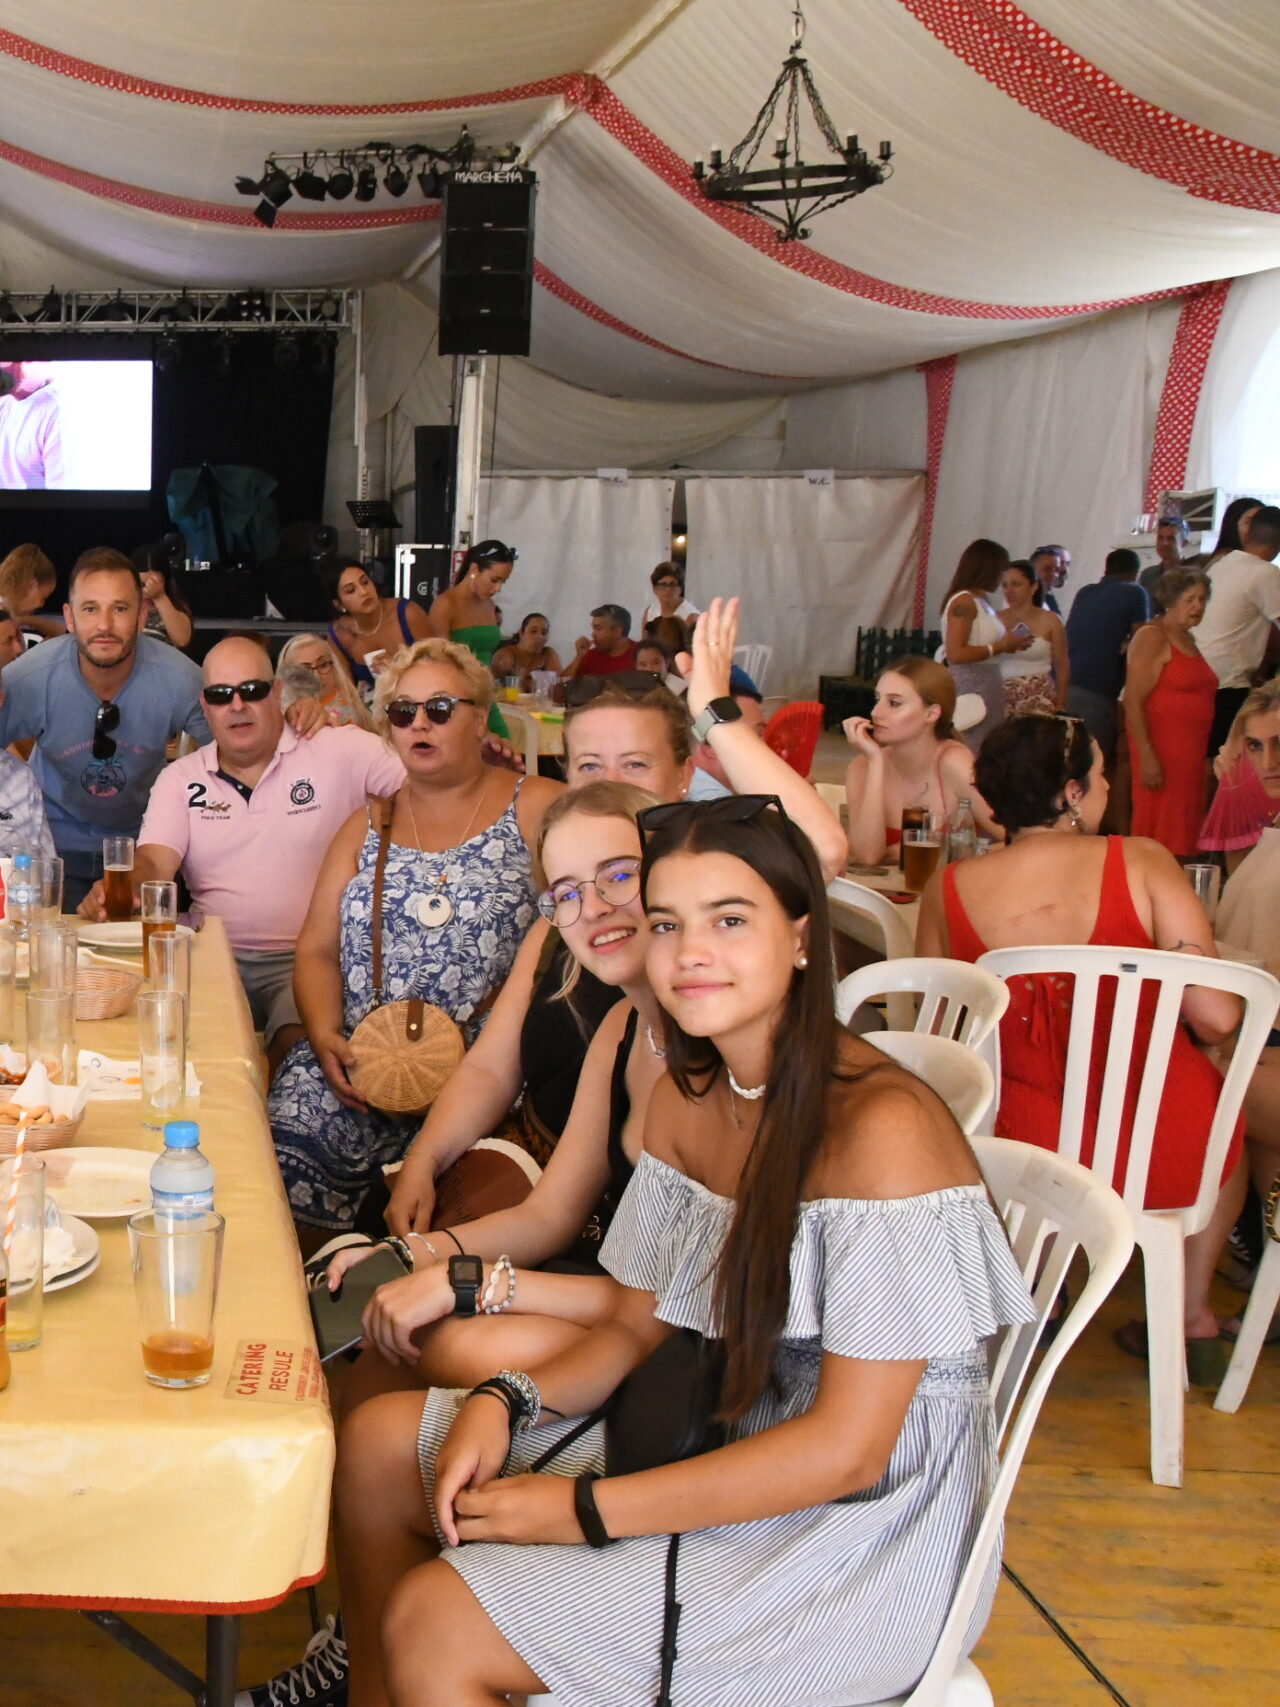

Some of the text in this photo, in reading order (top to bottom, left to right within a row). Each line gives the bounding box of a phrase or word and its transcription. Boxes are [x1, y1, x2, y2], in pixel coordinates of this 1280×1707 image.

[187, 782, 207, 808] 2
[236, 1343, 267, 1395] CATERING
[269, 1350, 294, 1392] RESULE
